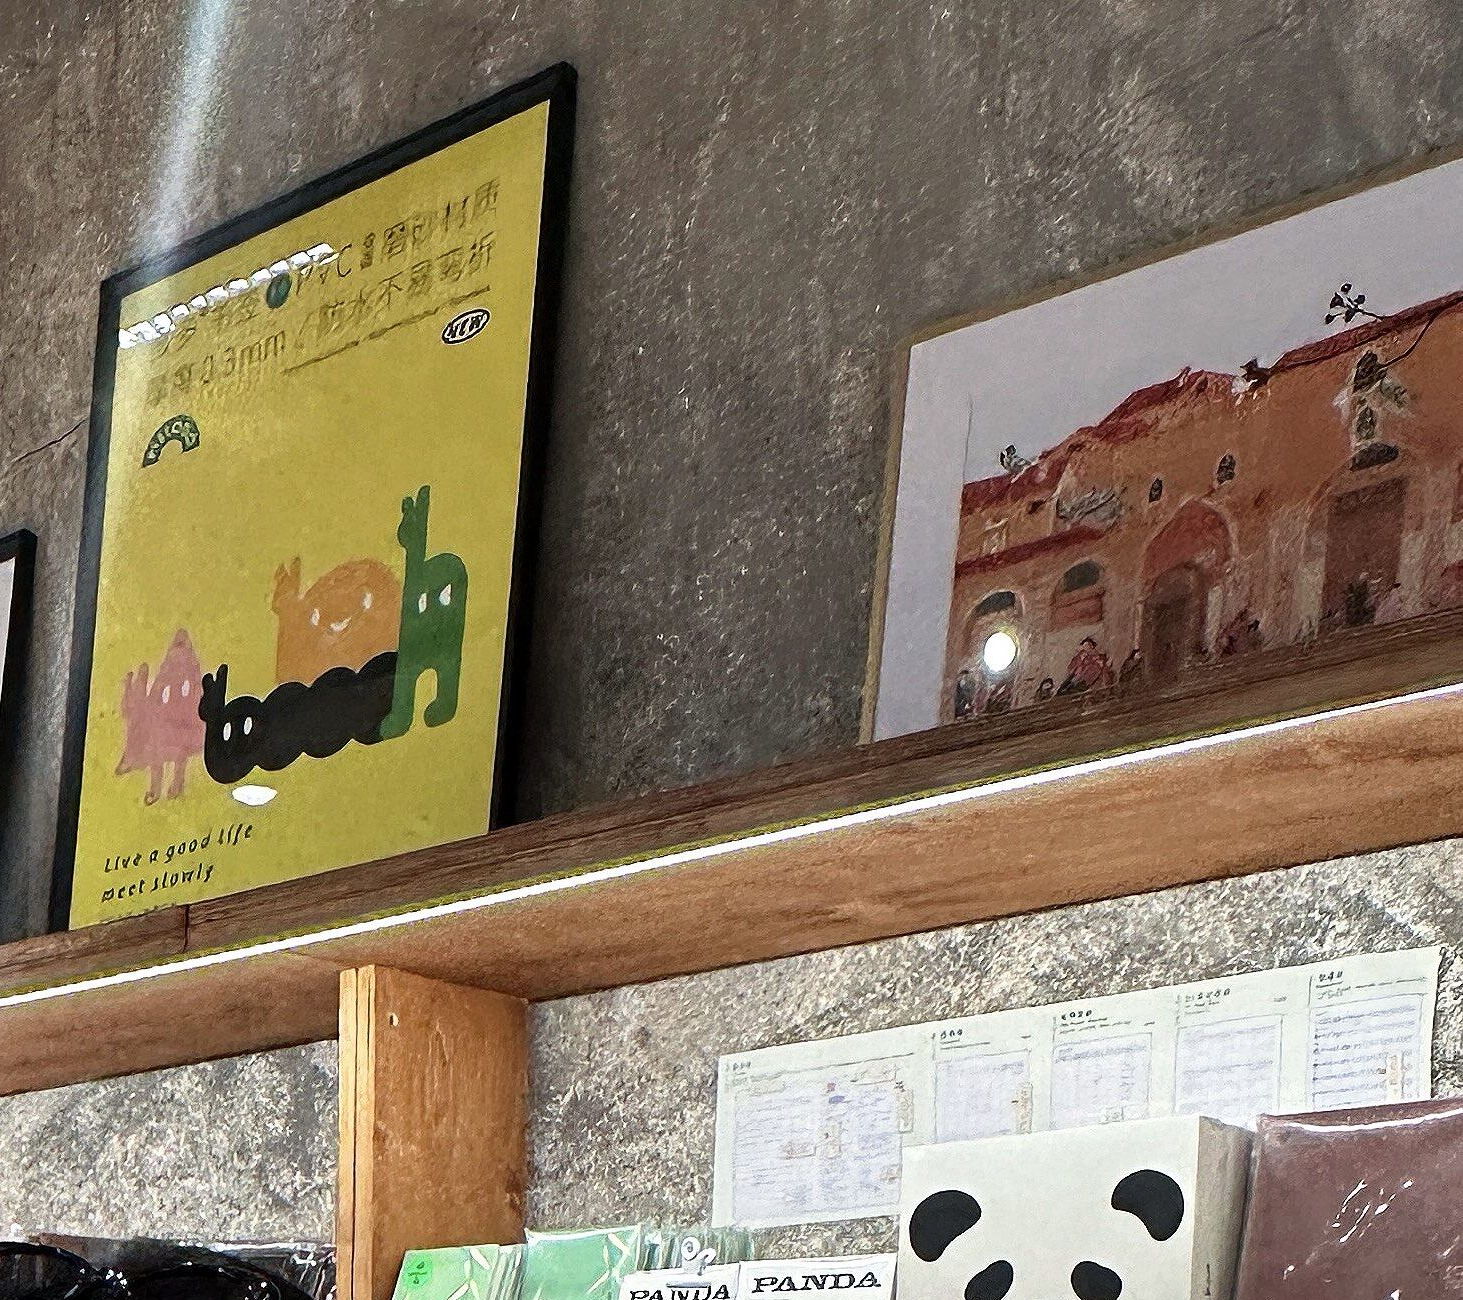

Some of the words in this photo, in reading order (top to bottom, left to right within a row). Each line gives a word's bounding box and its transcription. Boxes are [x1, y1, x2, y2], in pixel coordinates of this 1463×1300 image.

[104, 852, 143, 873] Live
[163, 827, 213, 864] good
[149, 861, 215, 894] slowly
[751, 1271, 883, 1294] PANDA
